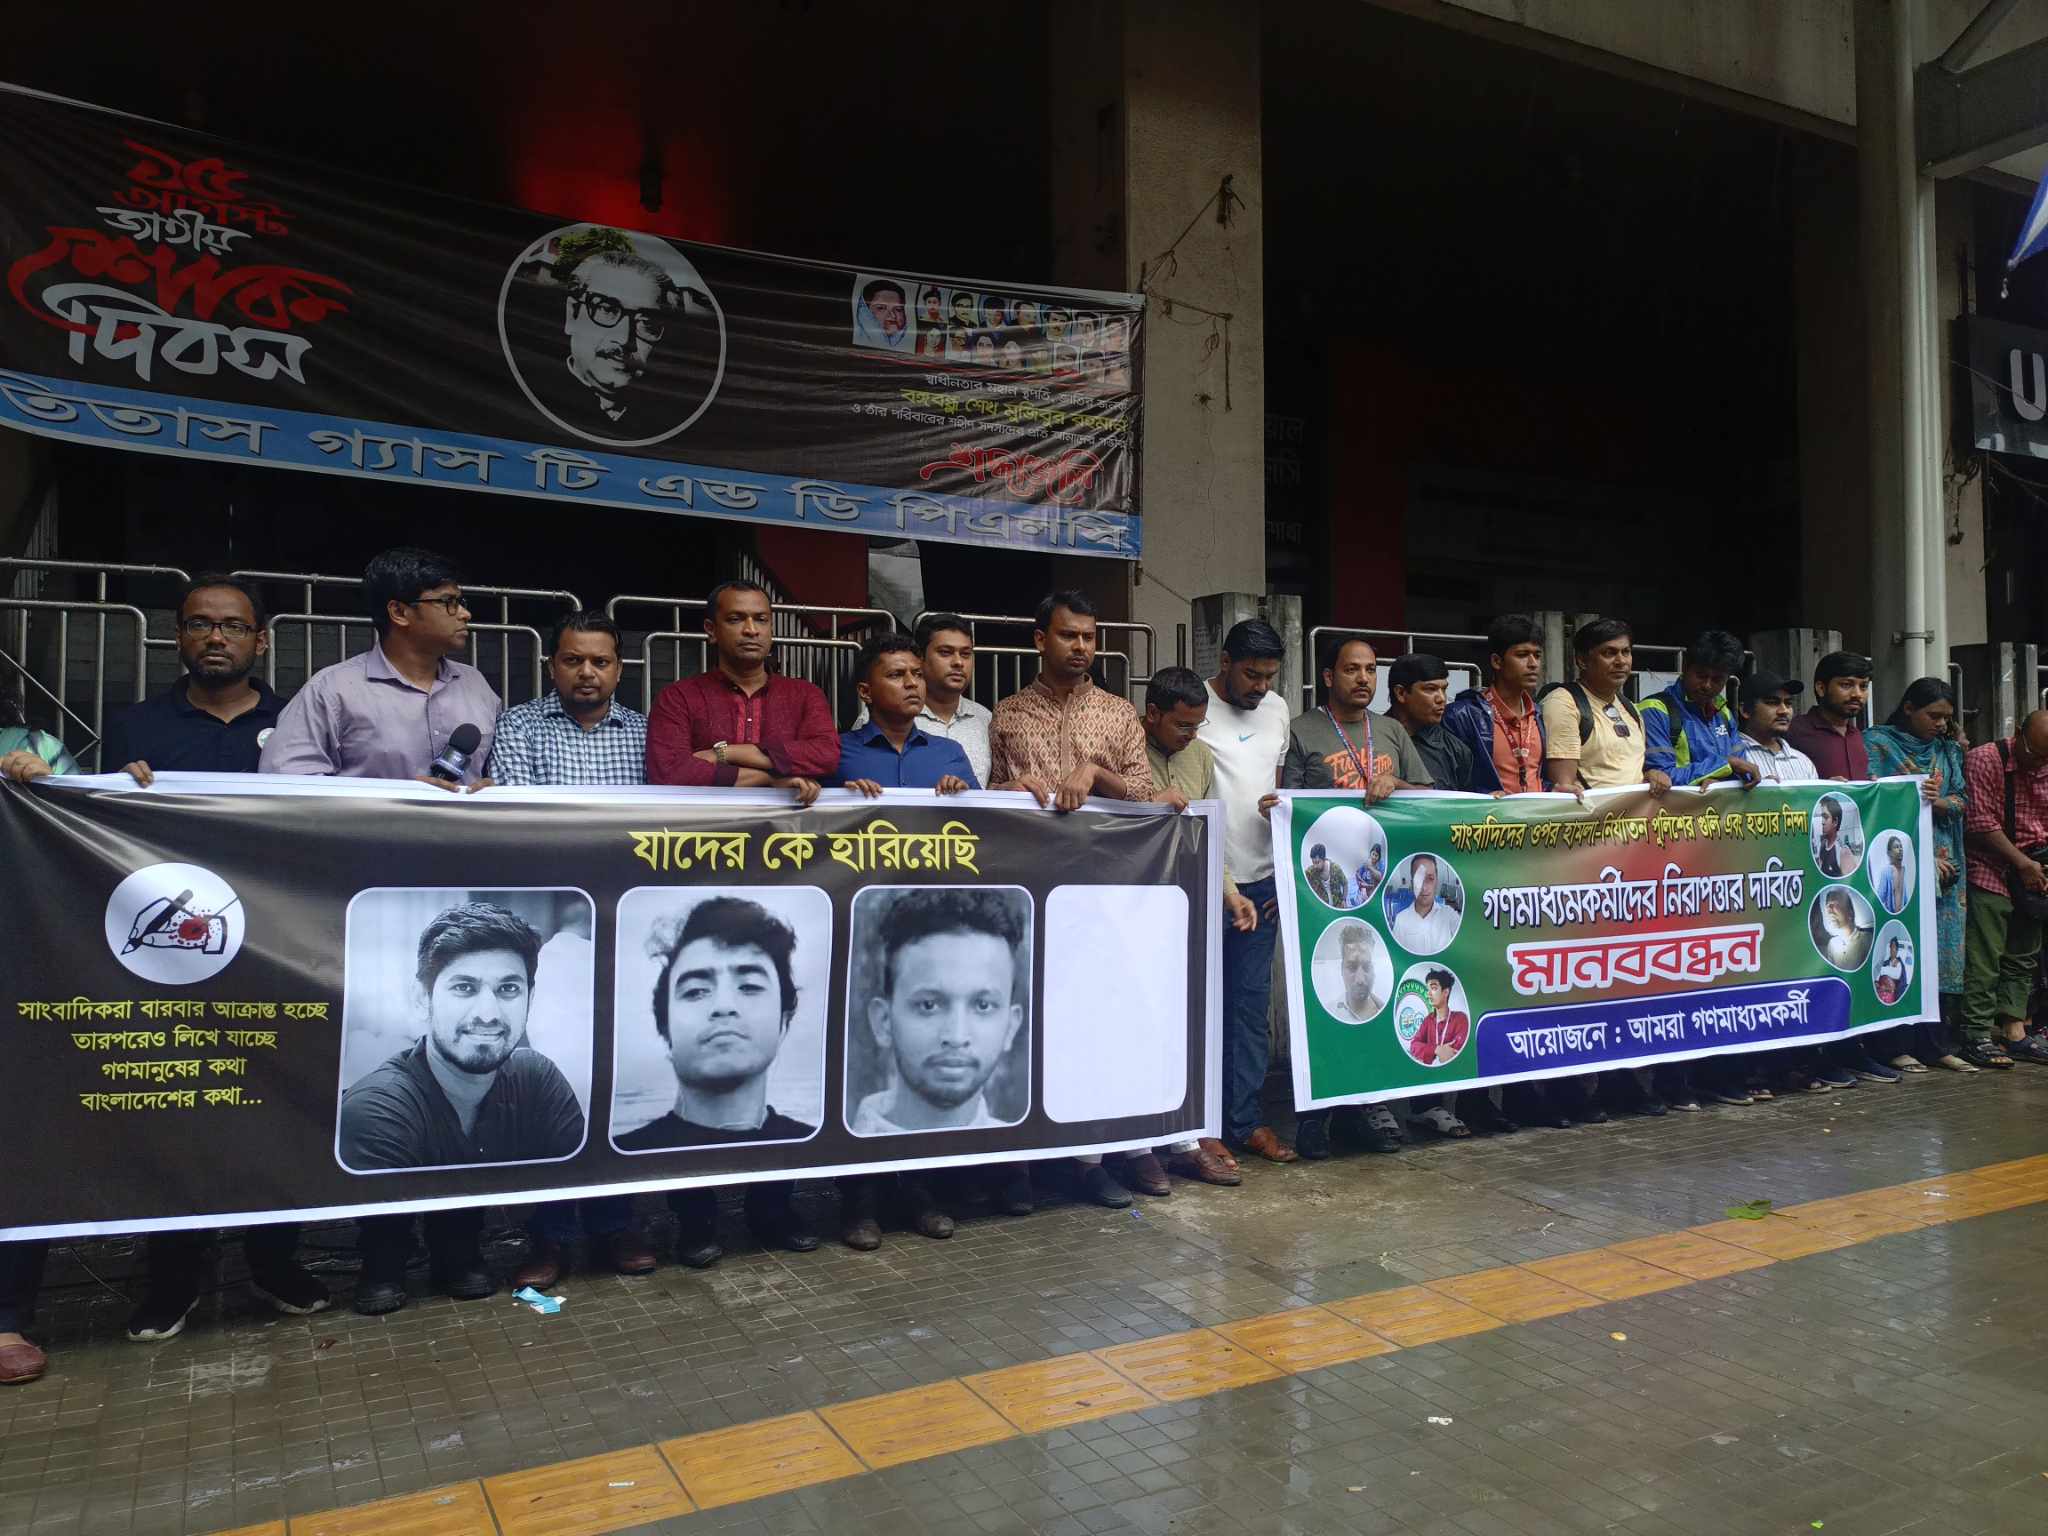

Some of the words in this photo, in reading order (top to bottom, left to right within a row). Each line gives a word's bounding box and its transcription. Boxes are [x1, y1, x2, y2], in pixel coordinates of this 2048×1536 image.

[123, 138, 249, 199] ১৫
[96, 207, 253, 255] জাতীয়
[112, 188, 297, 237] আগস্ট
[7, 226, 354, 341] শোক
[42, 282, 312, 384] দিবস
[925, 373, 983, 392] স্বাধীনতার
[851, 403, 861, 413] ও
[891, 407, 945, 426] পরিবারের
[899, 388, 961, 414] বঙ্গবন্ধু
[965, 398, 997, 416] শেখ
[1003, 401, 1066, 428] মুজিবুর
[308, 427, 505, 482] গ্যাস
[521, 447, 612, 490] টি
[639, 475, 769, 508] এন্ড
[783, 480, 872, 521] ডি
[628, 827, 751, 871] যাদের
[762, 832, 818, 870] কে
[826, 819, 980, 875] হারিয়েছি
[1530, 819, 1562, 849] ওপর
[1652, 807, 1696, 849] পুলিশের
[1697, 806, 1721, 840] গুলি
[1724, 813, 1744, 840] এবং
[1746, 811, 1780, 839] হত্যার
[1782, 803, 1808, 835] নিন্দা
[1482, 866, 1657, 928] গণমাধ্যমকর্মীদের
[1663, 863, 1743, 917] নিরাপত্তার
[1748, 856, 1804, 909] দাবিতে
[1511, 930, 1761, 989] মানববন্ধন
[18, 997, 133, 1020] সাংবাদিকরা
[139, 1000, 205, 1018] বারবার
[212, 1001, 277, 1019] আক্রান্ত
[282, 1002, 329, 1020] হচ্ছে
[1507, 1021, 1607, 1060] আয়োজনে
[1627, 1010, 1685, 1045] আমরা
[1692, 988, 1811, 1036] গণমাধ্যমকর্মী
[72, 1031, 165, 1050] তারপরেও
[172, 1025, 219, 1048] লিখে
[226, 1029, 278, 1048] যাচ্ছে
[102, 1059, 202, 1083] গণমানুষের
[207, 1057, 247, 1076] কথা
[80, 1090, 197, 1111] বাংলাদেশের
[204, 1087, 262, 1106] কথা...
